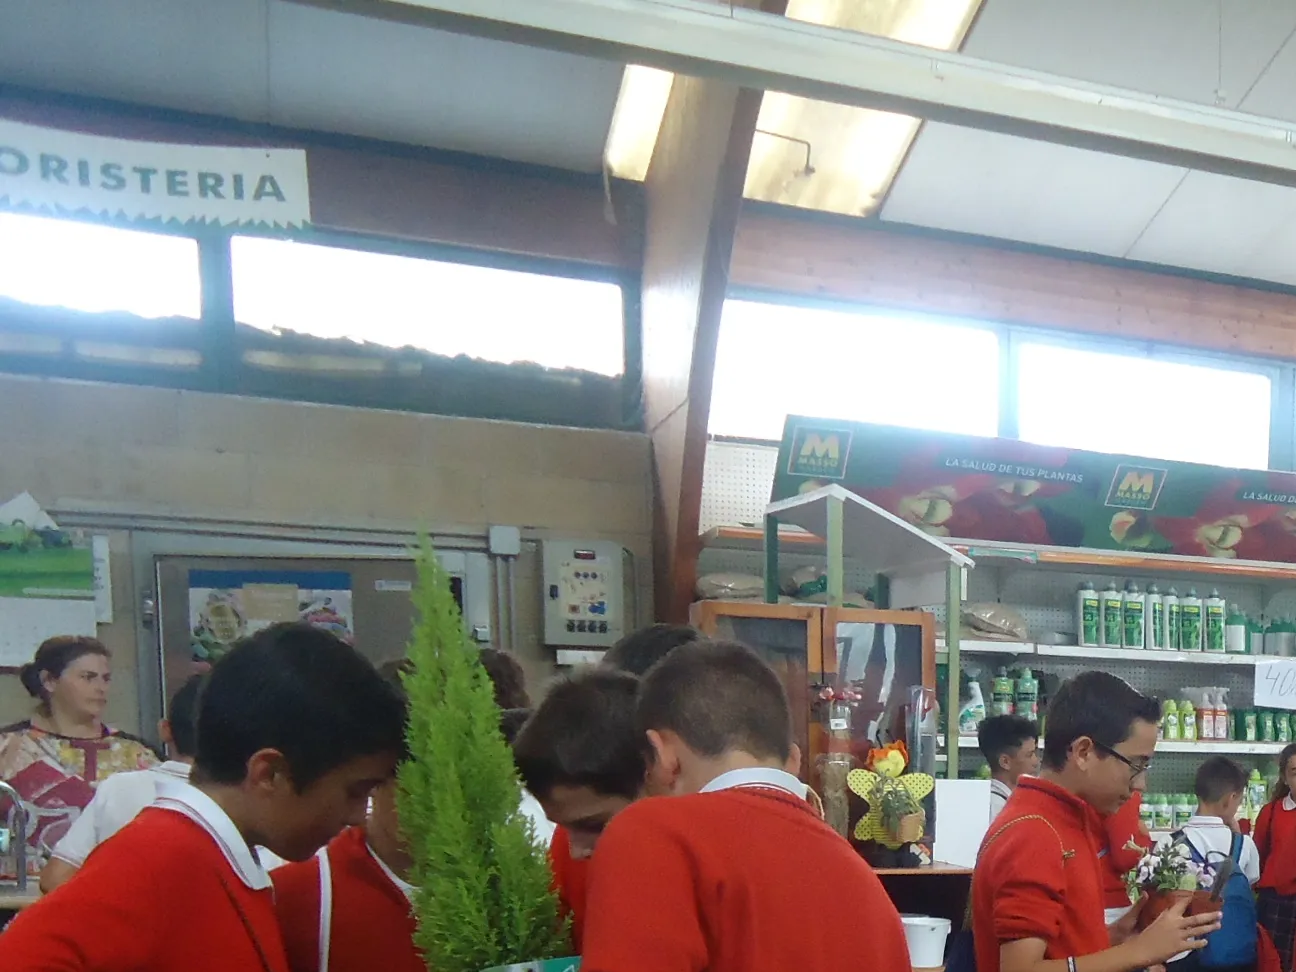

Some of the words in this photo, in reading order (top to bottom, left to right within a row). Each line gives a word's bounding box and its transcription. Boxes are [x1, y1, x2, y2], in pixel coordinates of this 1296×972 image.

[945, 457, 960, 467] LA
[961, 459, 997, 472] SALUD
[999, 464, 1013, 474] DE
[1016, 466, 1037, 477] TUS
[1037, 469, 1083, 483] PLANTAS
[1243, 491, 1256, 500] LA
[1256, 493, 1287, 504] SALUD
